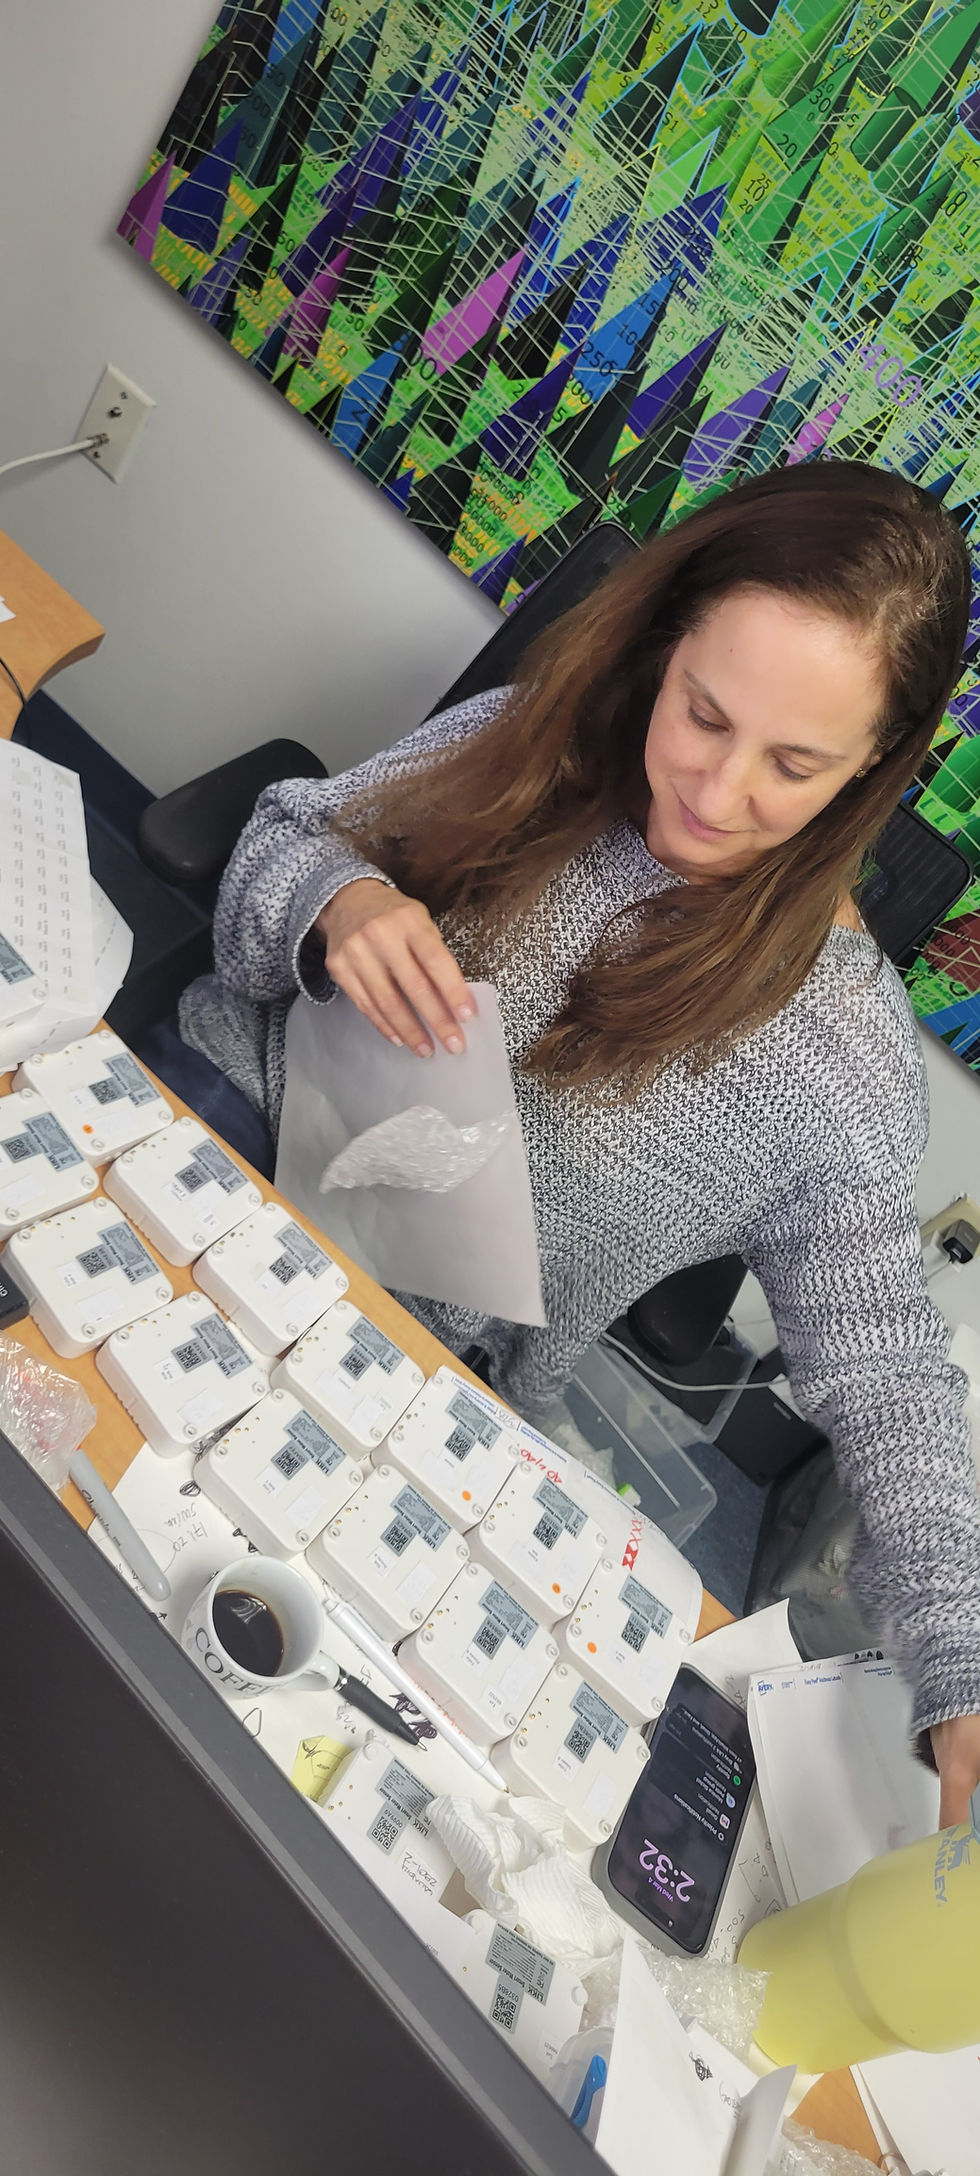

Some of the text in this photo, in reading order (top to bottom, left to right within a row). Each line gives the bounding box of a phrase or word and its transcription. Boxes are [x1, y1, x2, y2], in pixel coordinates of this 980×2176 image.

[729, 21, 748, 43] 10
[808, 87, 832, 114] 30
[776, 133, 798, 158] 20
[745, 179, 764, 202] 10
[756, 172, 772, 190] 25
[953, 240, 968, 257] 25
[616, 322, 638, 346] 10
[858, 343, 922, 408] 400
[673, 1793, 717, 1834] Priority Notifications
[412, 1819, 428, 1836] LIKK
[638, 1839, 695, 1904] 2:32
[488, 1958, 544, 2001] LIKK Smart Water Sensor
